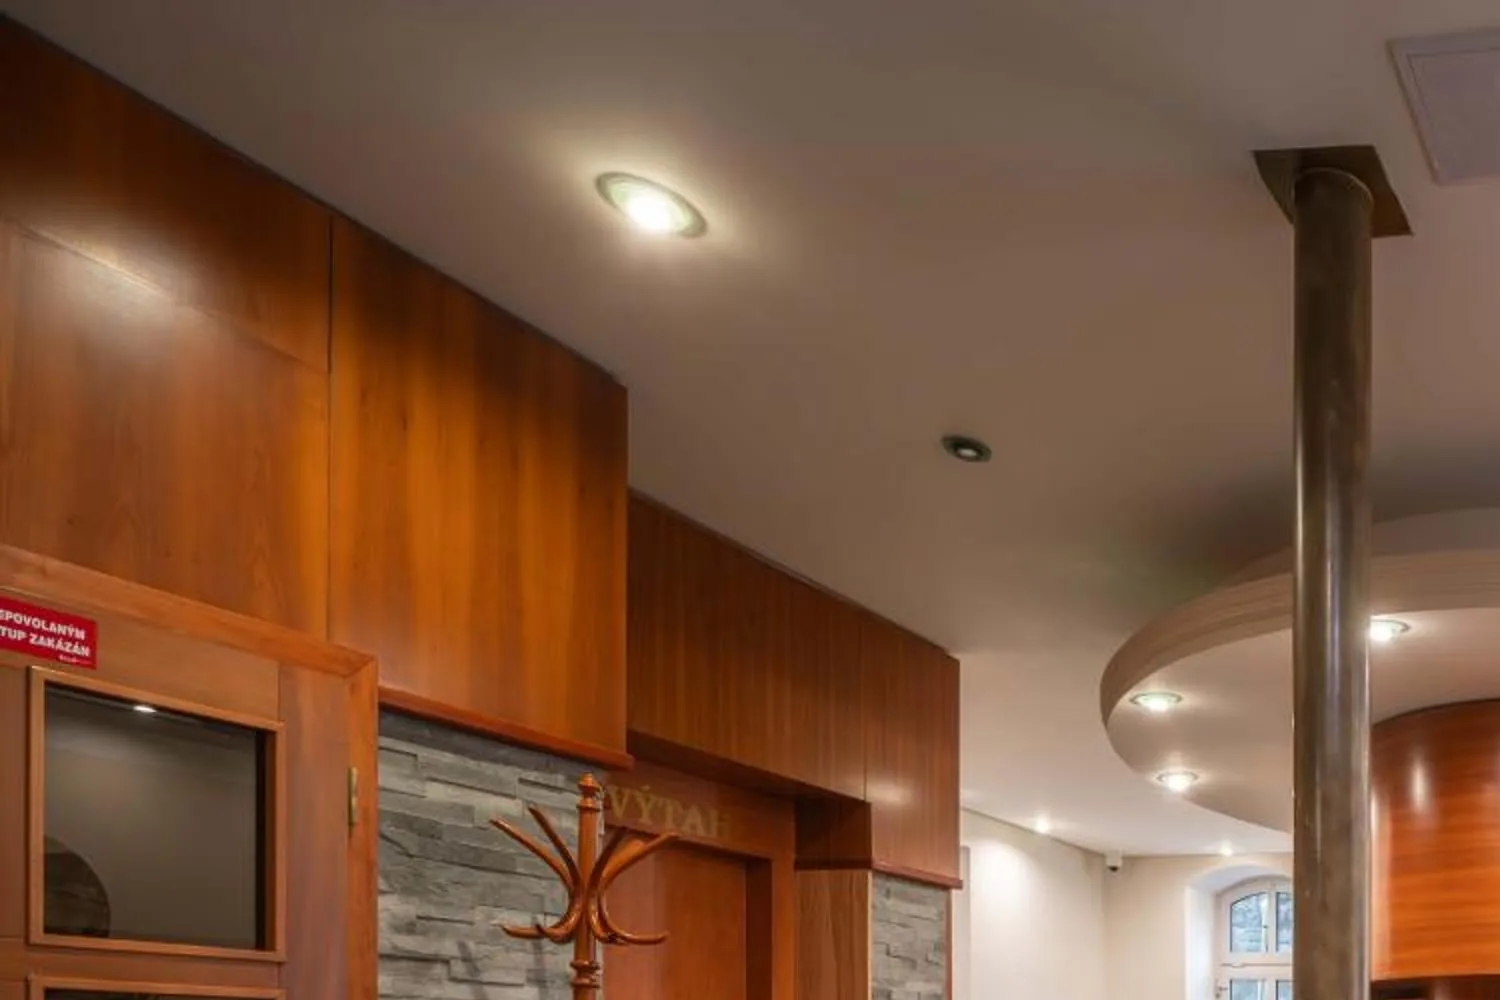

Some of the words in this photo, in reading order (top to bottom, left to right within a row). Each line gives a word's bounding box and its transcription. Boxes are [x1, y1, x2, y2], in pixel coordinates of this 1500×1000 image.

[0, 609, 86, 641] EPOVOLANÝM
[0, 625, 26, 641] TUP
[28, 632, 91, 657] ZAKÁZÁN
